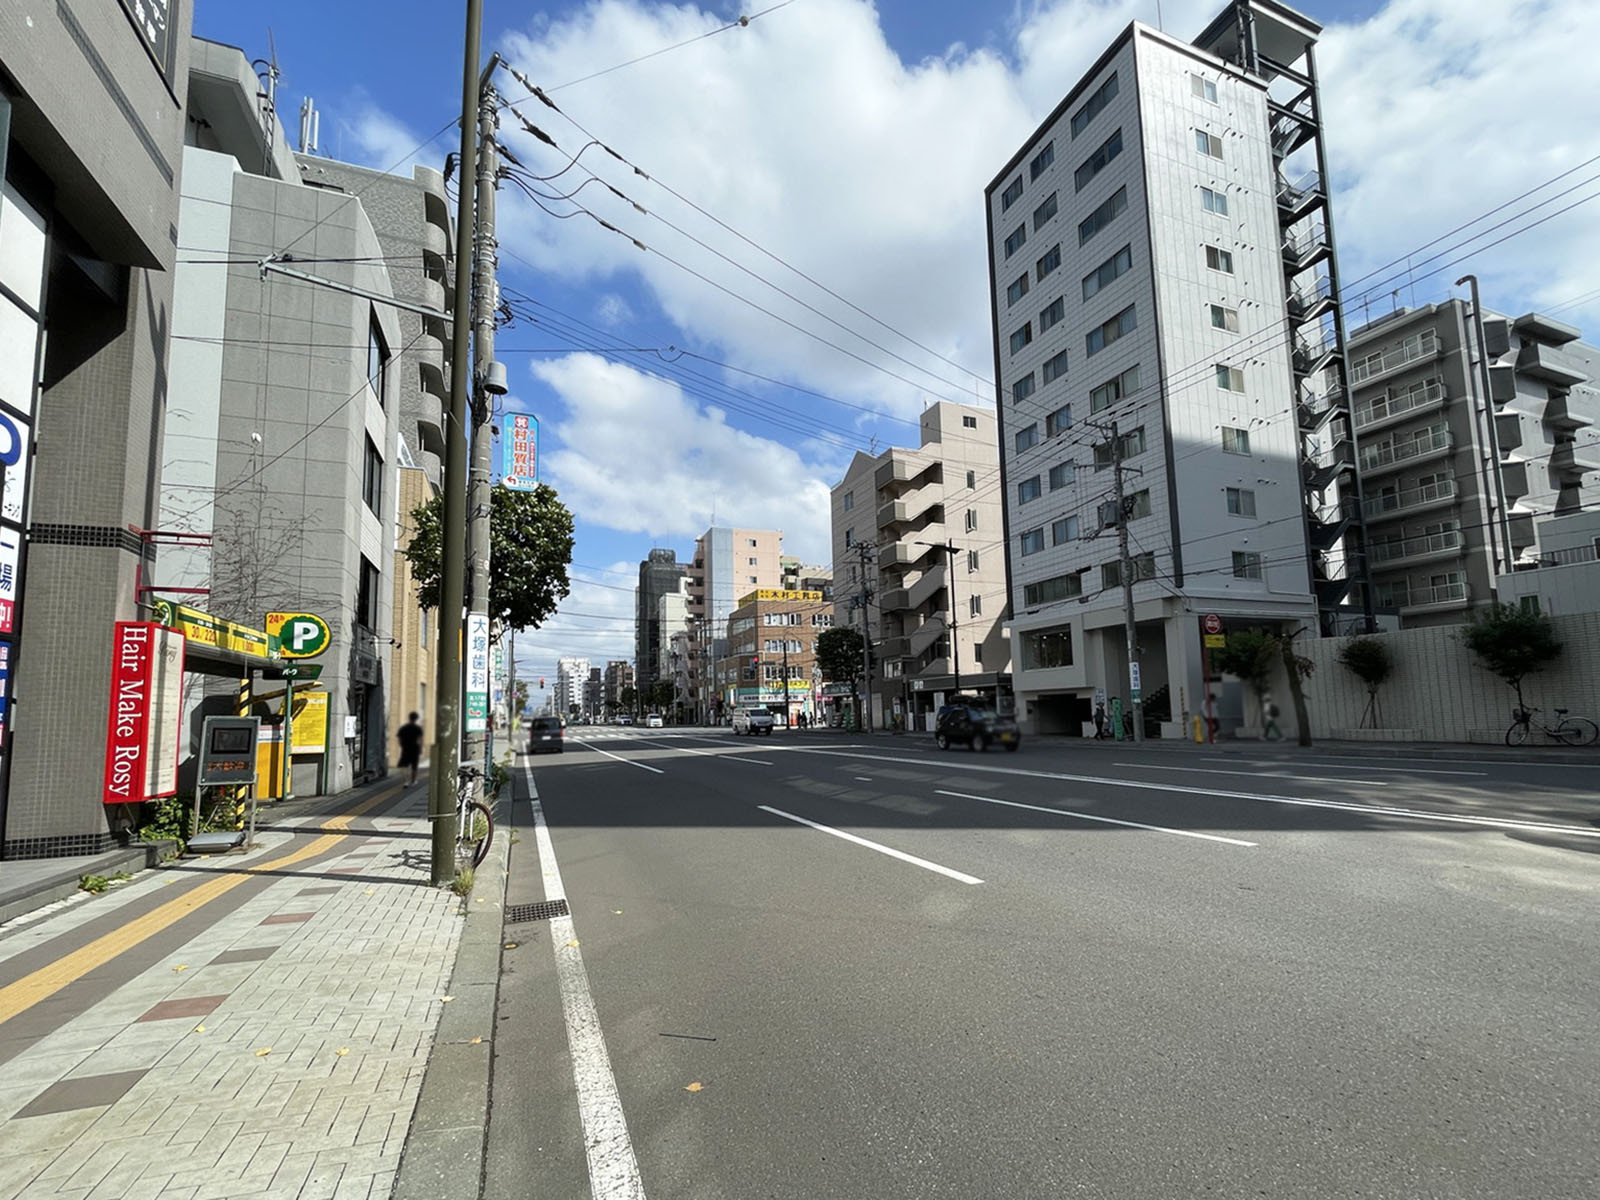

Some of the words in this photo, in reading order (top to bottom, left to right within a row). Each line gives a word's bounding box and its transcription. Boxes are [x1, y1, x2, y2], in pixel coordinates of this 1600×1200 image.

[121, 626, 148, 673] Hair
[293, 621, 319, 650] P
[471, 618, 487, 689] 大塚歯科
[116, 679, 145, 738] Make
[108, 745, 141, 797] Rosy
